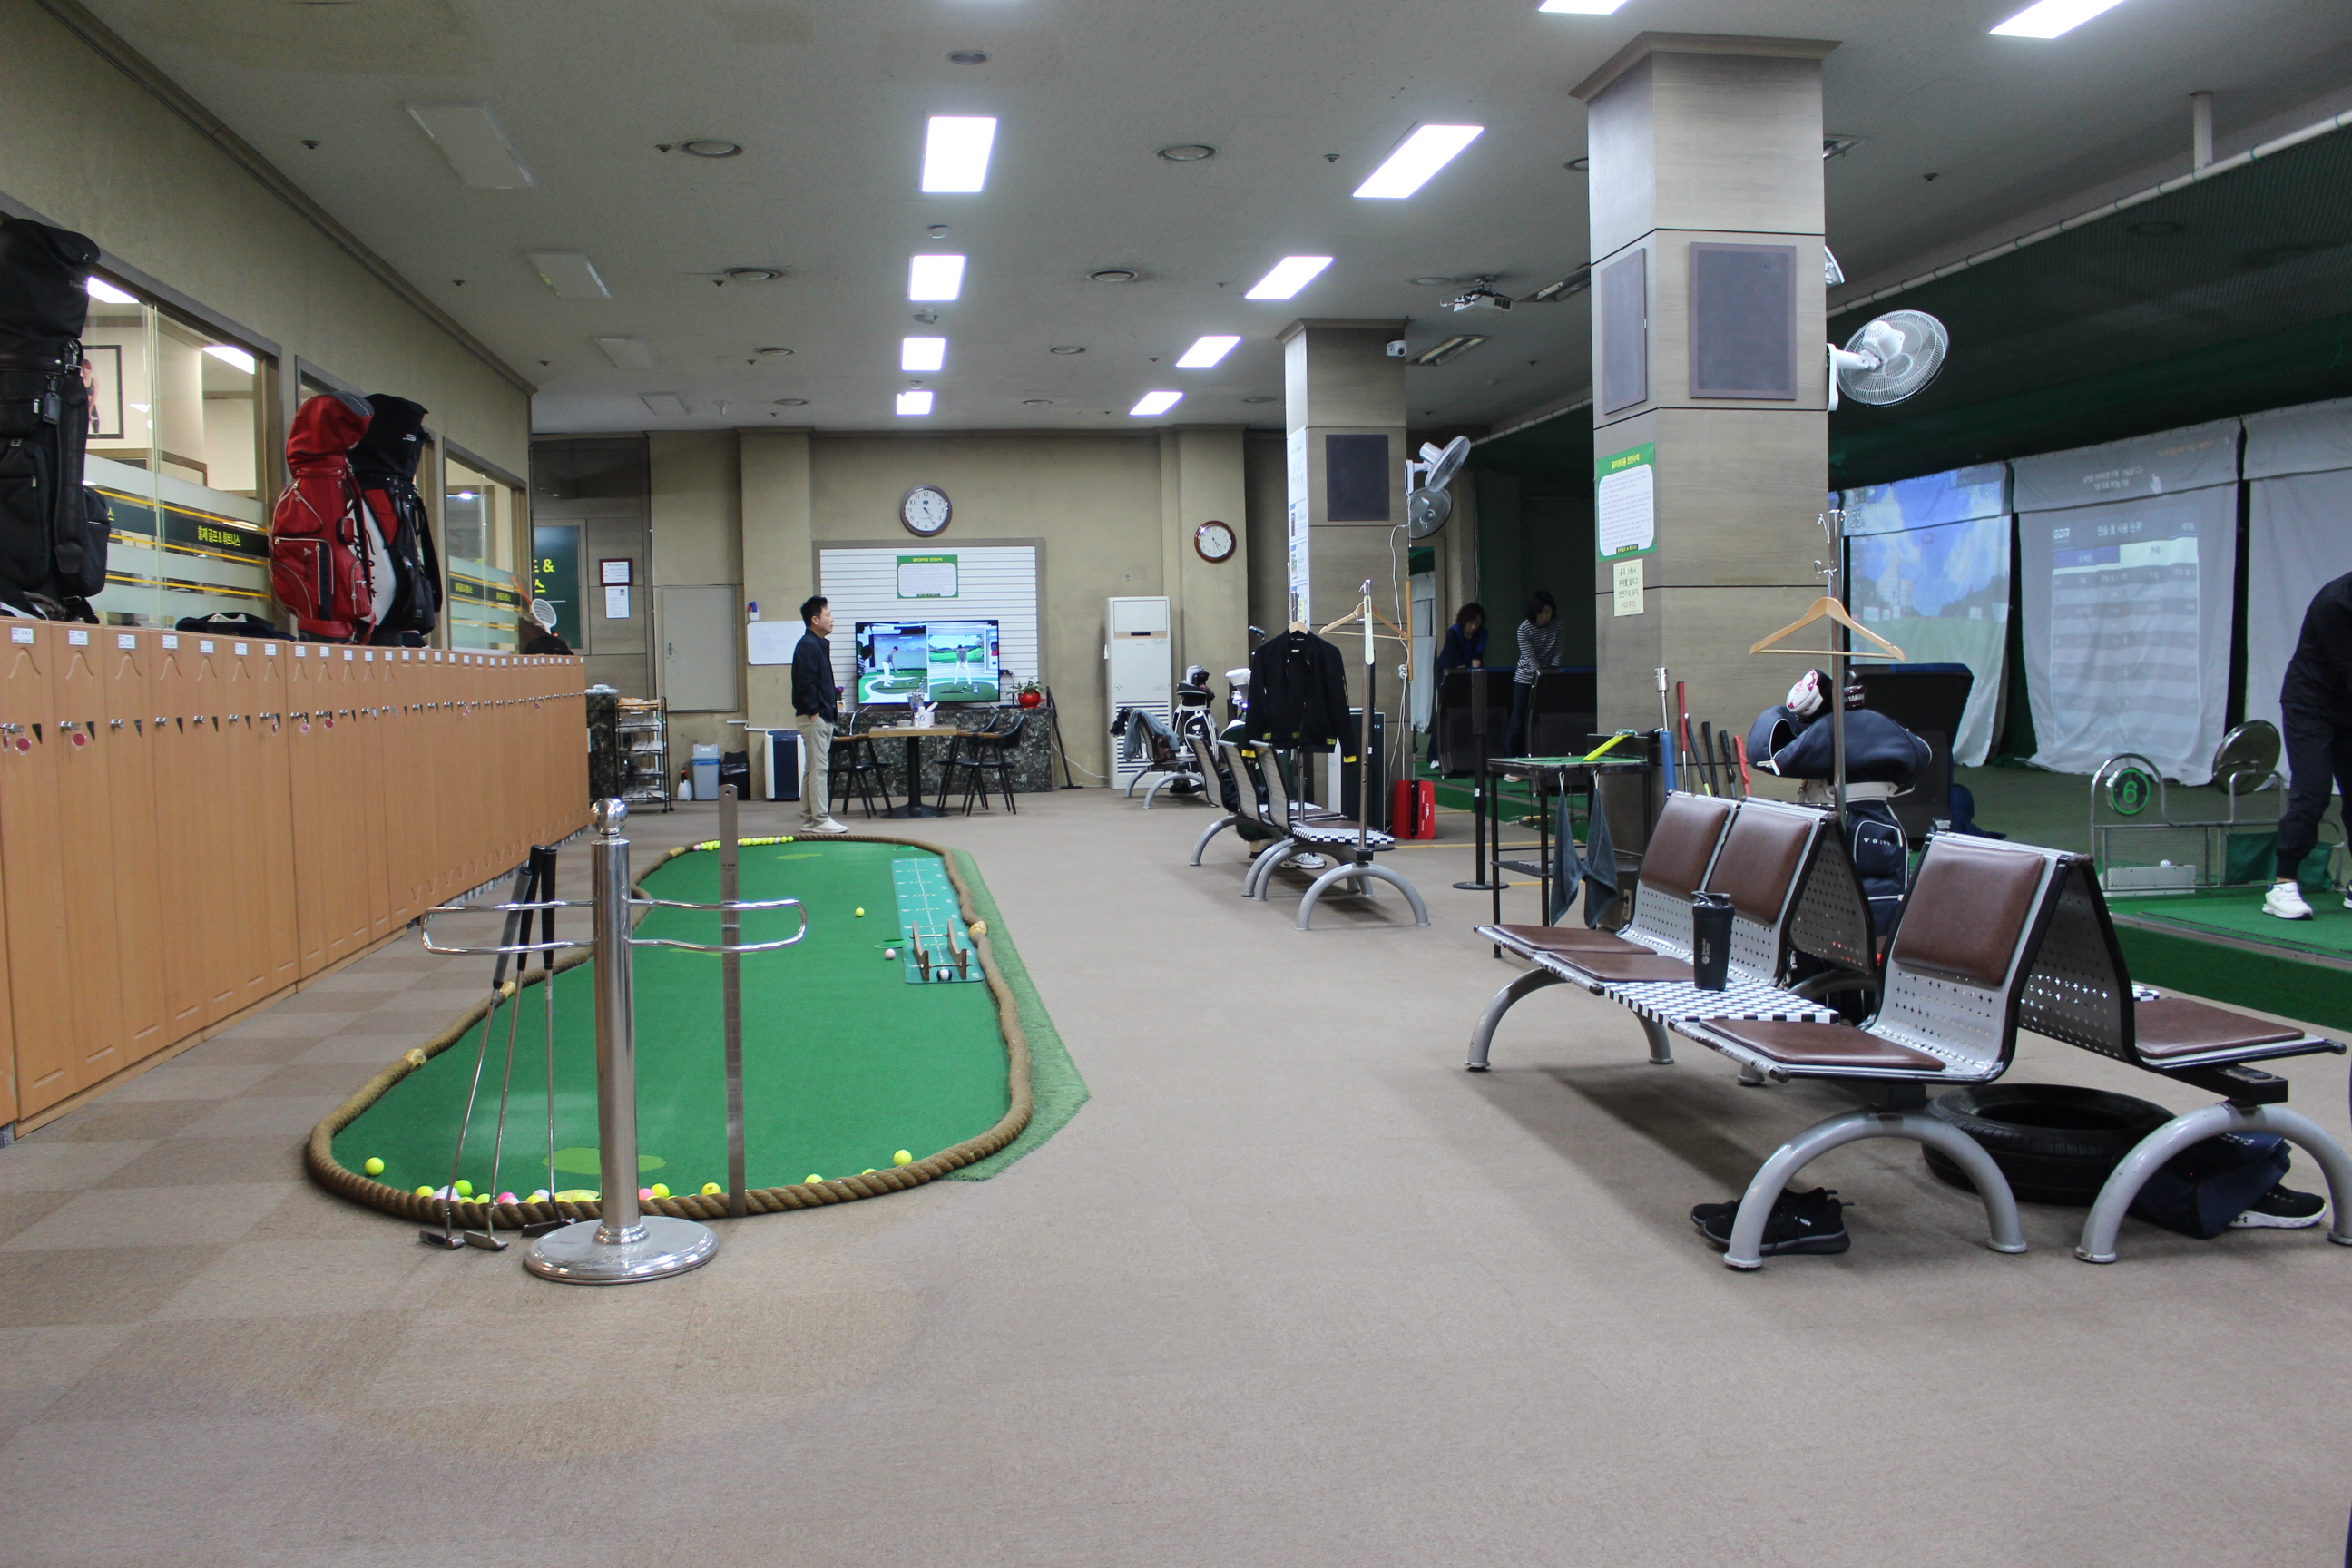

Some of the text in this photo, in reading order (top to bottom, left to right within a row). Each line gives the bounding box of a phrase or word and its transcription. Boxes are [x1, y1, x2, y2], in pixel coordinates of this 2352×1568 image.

[197, 525, 241, 547] 홍제 골프 & 휘트니스
[543, 558, 554, 573] &
[2123, 780, 2138, 804] 6
